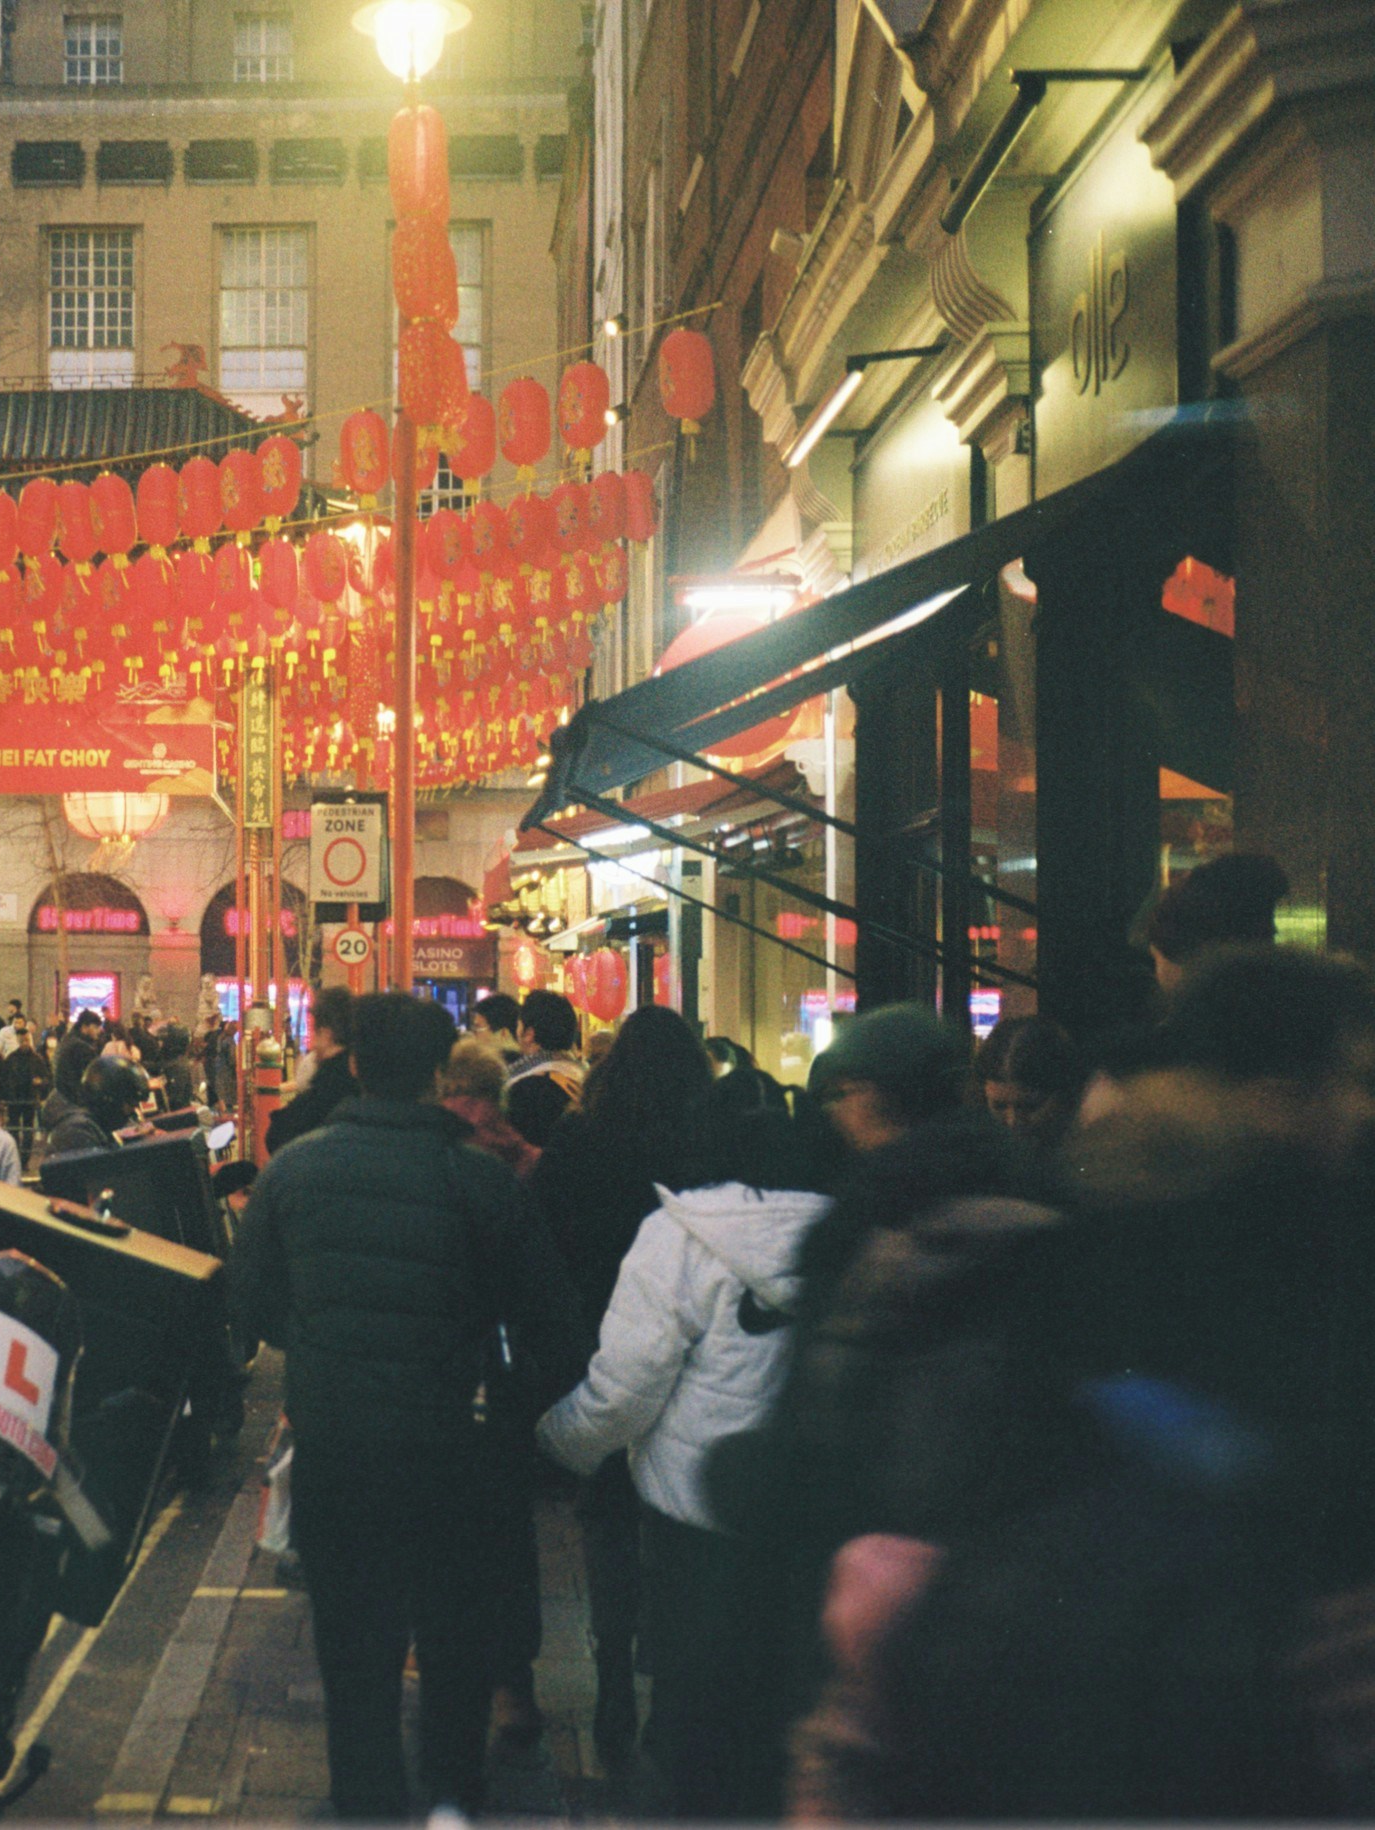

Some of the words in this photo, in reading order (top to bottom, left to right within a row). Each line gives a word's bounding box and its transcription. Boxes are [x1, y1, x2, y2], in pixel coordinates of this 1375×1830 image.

[24, 748, 58, 767] FAT
[59, 748, 112, 767] CHOY
[317, 808, 374, 816] PEDESTRIAN
[325, 819, 366, 832] ZONE
[320, 889, 332, 897] No
[334, 889, 368, 898] vehicles
[38, 905, 140, 931] SiverTime
[339, 939, 367, 955] 20
[412, 961, 458, 972] SLOTS
[4, 1339, 41, 1407] L
